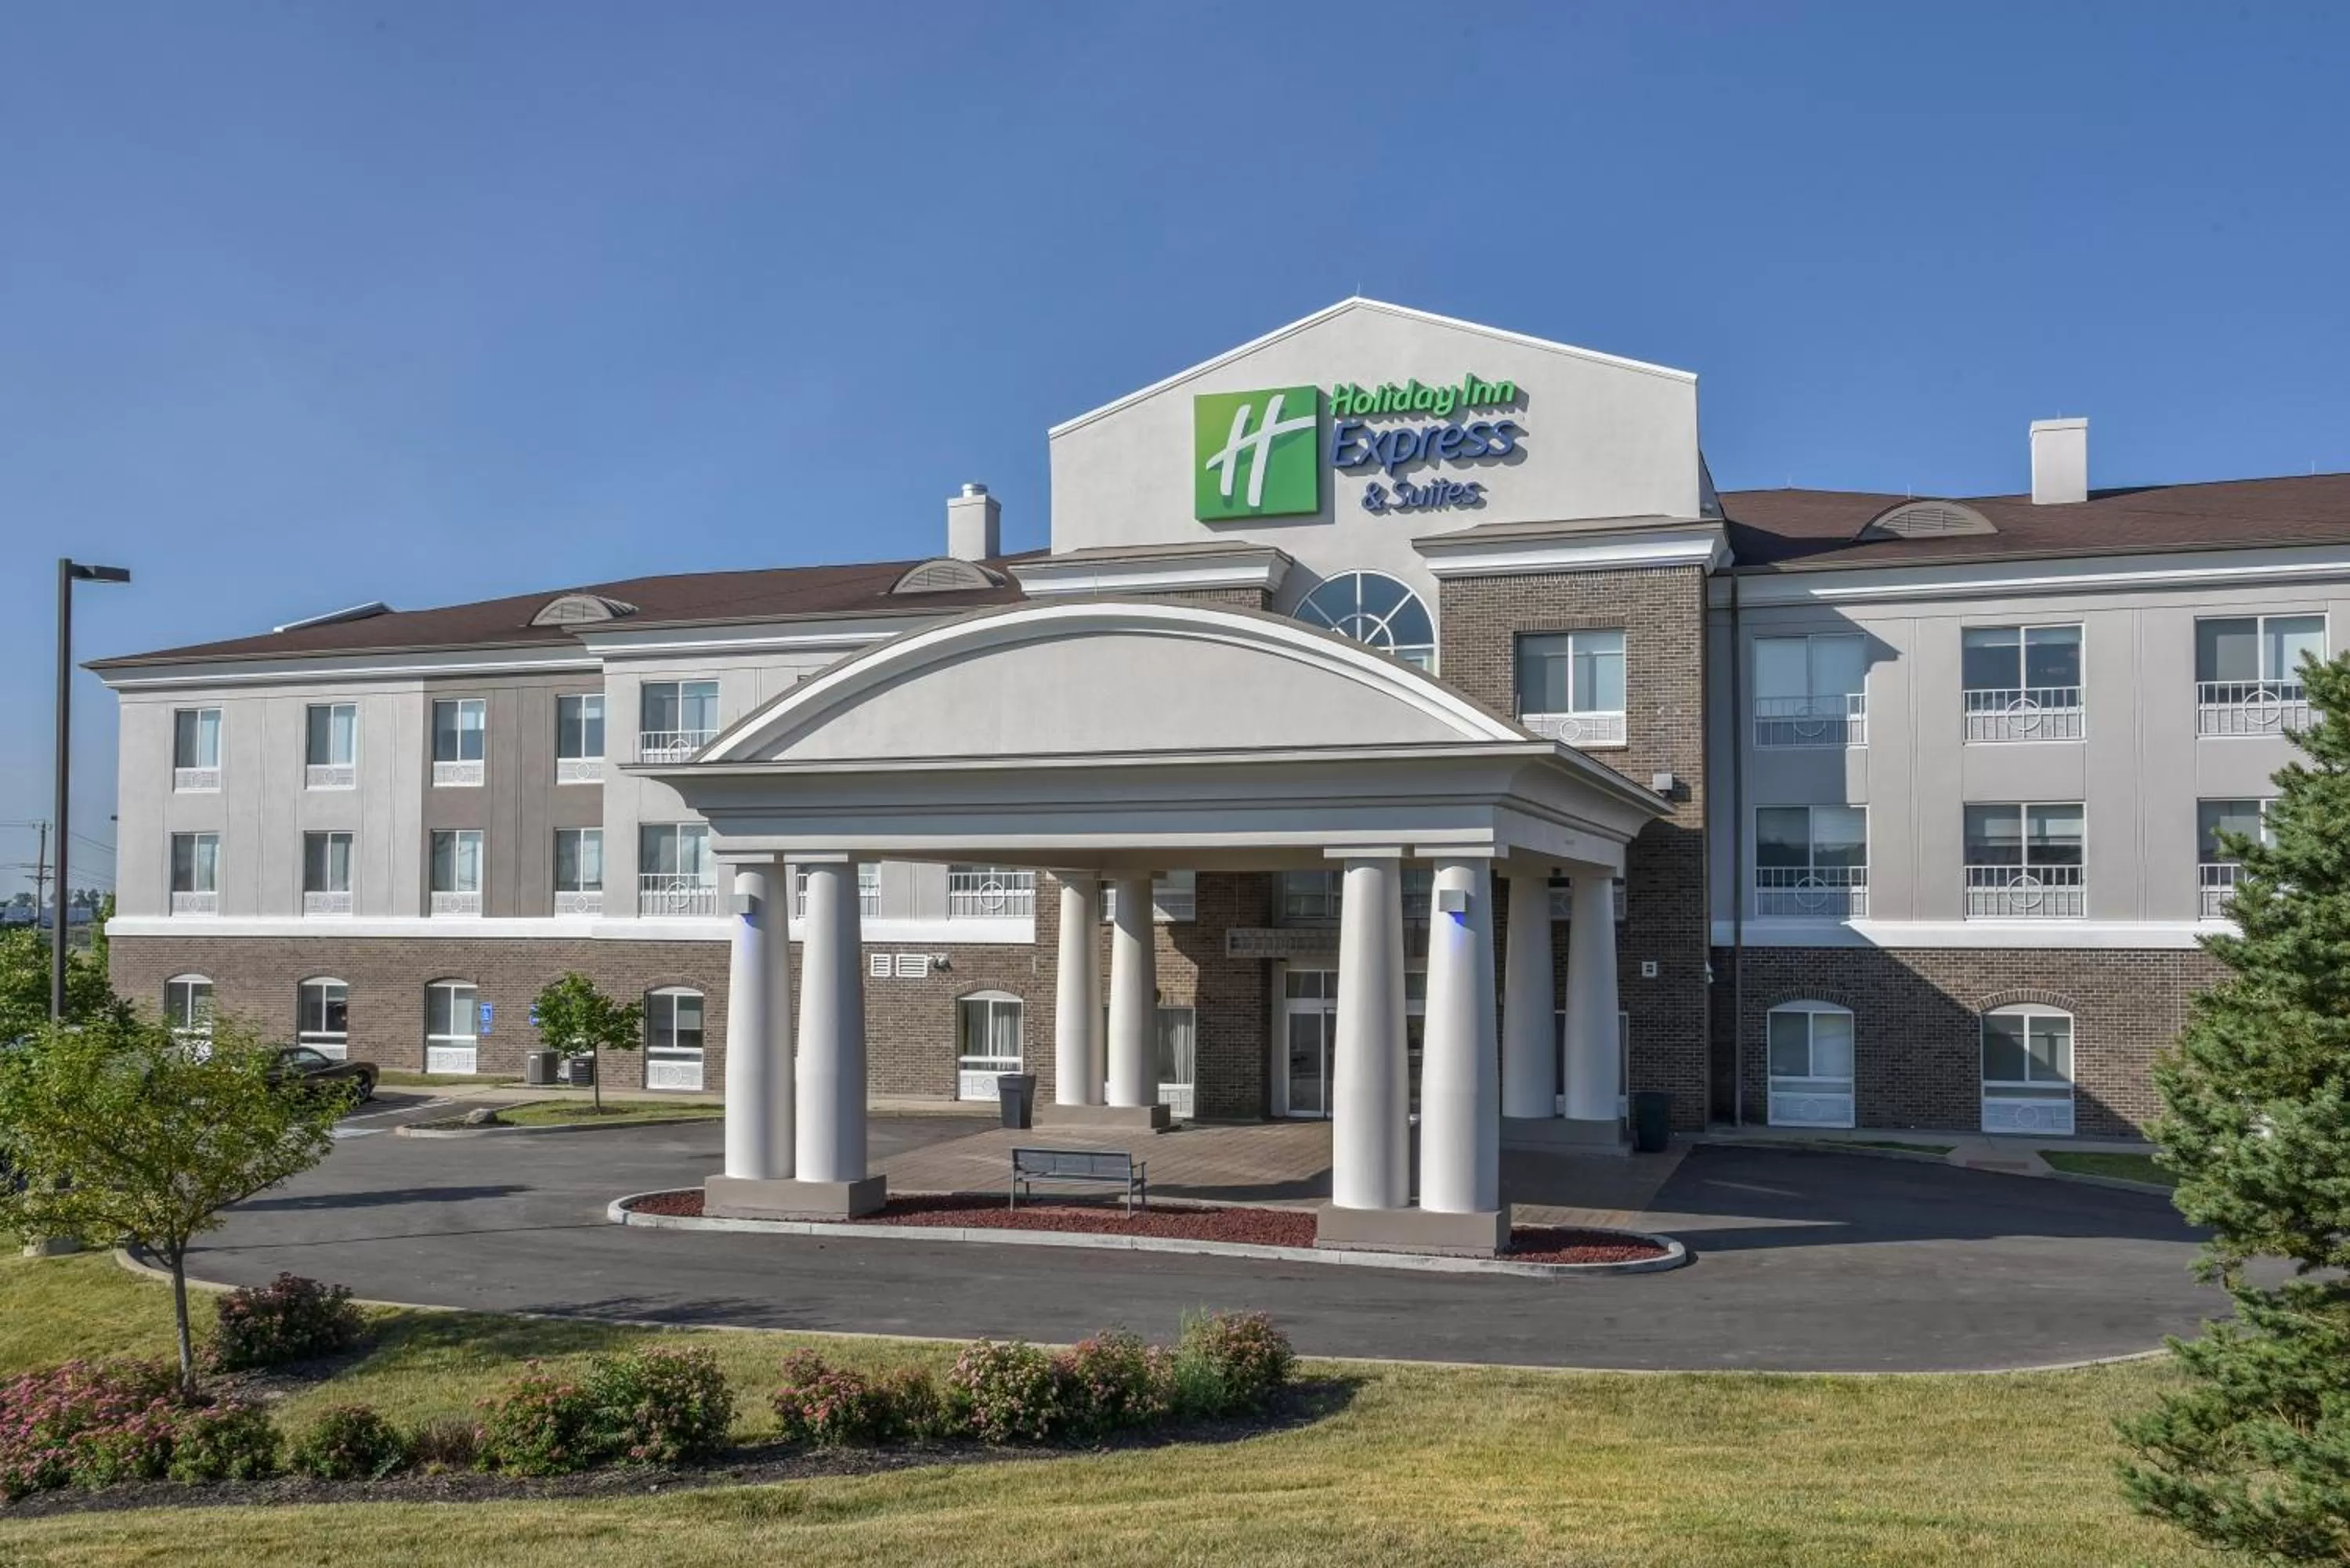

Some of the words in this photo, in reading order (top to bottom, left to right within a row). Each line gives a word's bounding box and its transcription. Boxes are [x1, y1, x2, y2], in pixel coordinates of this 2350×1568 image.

[1329, 380, 1455, 416] Holiday
[1462, 374, 1515, 406] Inn
[1332, 420, 1515, 477] Express
[1361, 482, 1383, 510] &
[1392, 478, 1480, 508] Suites
